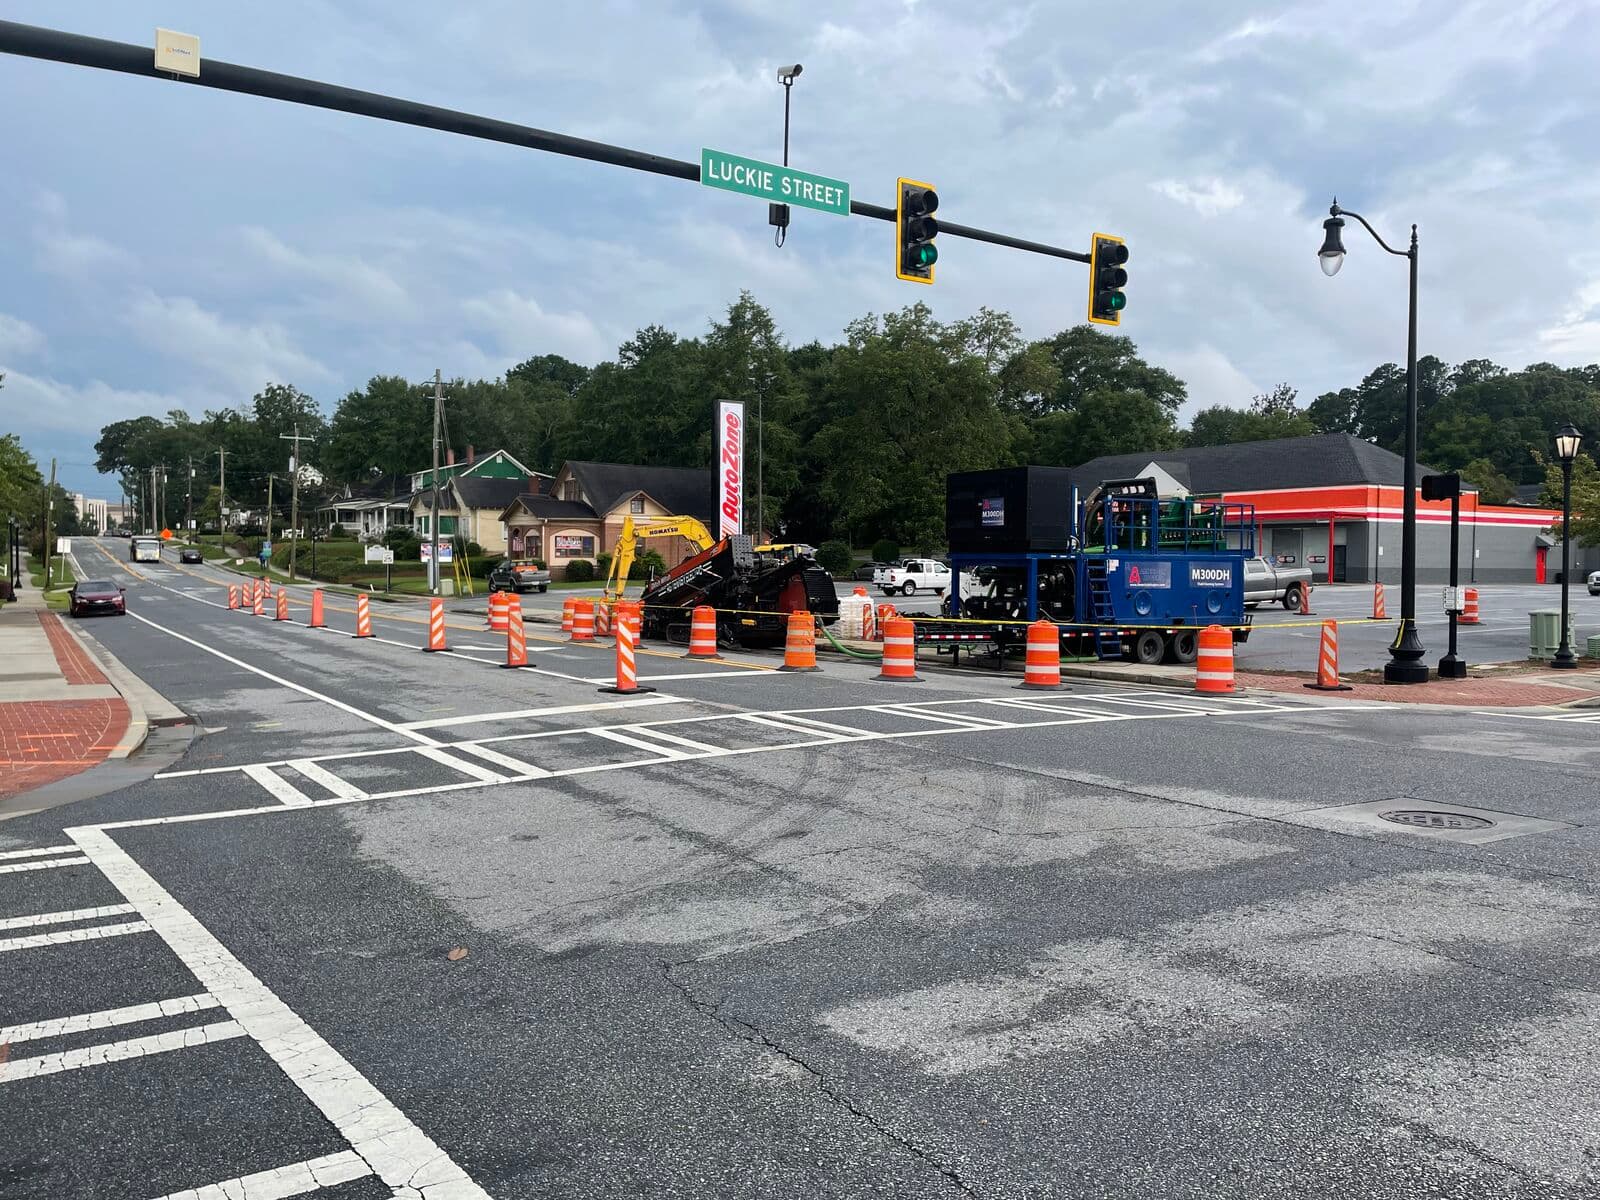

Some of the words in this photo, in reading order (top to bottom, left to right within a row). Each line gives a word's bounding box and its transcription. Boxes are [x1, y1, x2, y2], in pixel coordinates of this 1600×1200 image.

[708, 159, 773, 191] LUCKIE
[782, 177, 843, 206] STREET
[722, 411, 740, 523] AutoZone
[649, 527, 679, 535] KOMATSU
[1191, 569, 1230, 580] M300DH
